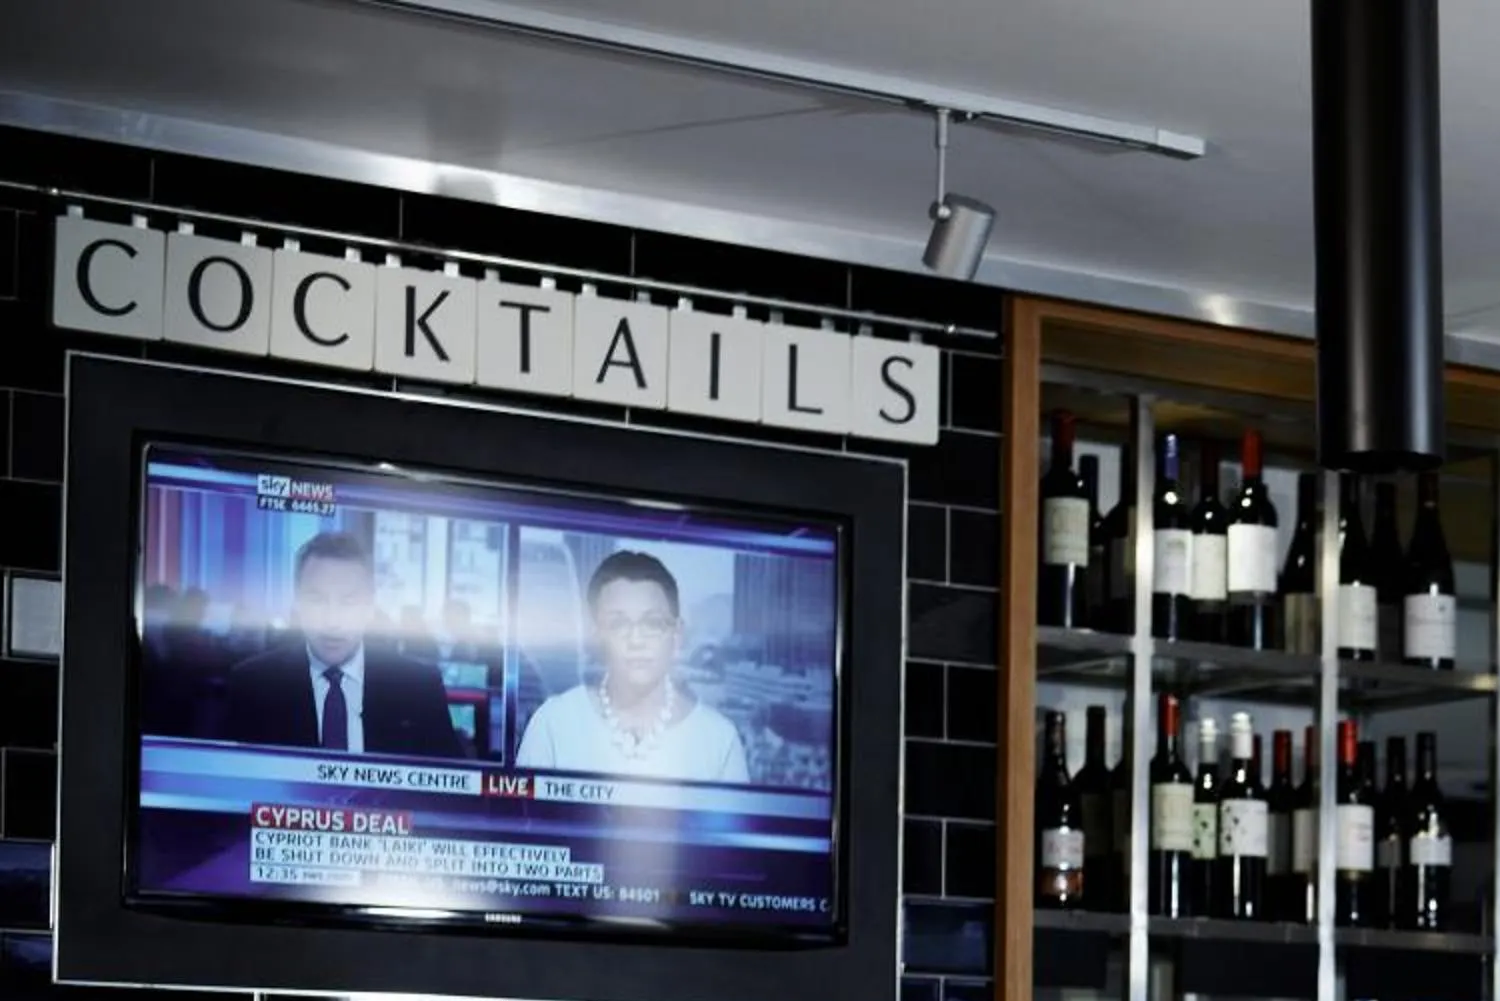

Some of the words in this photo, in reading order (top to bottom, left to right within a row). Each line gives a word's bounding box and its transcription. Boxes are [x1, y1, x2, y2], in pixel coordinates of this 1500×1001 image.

[75, 238, 917, 424] COCKTAILS
[291, 481, 335, 500] NEWS
[317, 764, 349, 781] SKY
[354, 768, 403, 785] NEWS
[407, 771, 471, 790] CENTRE
[488, 775, 529, 796] LIVE
[545, 781, 573, 797] THE
[579, 783, 615, 799] CITY
[256, 806, 345, 831] CYPRUS
[353, 812, 410, 835] DEAL
[255, 831, 322, 849] CYPRIOT
[329, 836, 371, 851] BANK
[433, 841, 468, 858] WILL
[473, 845, 568, 863] EFFECTIVELY
[255, 847, 274, 861] BE
[281, 849, 323, 864] SHUT
[329, 851, 381, 867] DOWN
[385, 855, 420, 869] AND
[424, 856, 464, 873] SPLIT
[471, 859, 508, 876] INTO
[515, 862, 549, 878] TWO
[555, 864, 601, 882] PARTS
[555, 883, 588, 897] TEXT
[690, 891, 715, 905] SKY
[719, 893, 736, 908] TV
[739, 894, 815, 912] CUSTOMERS
